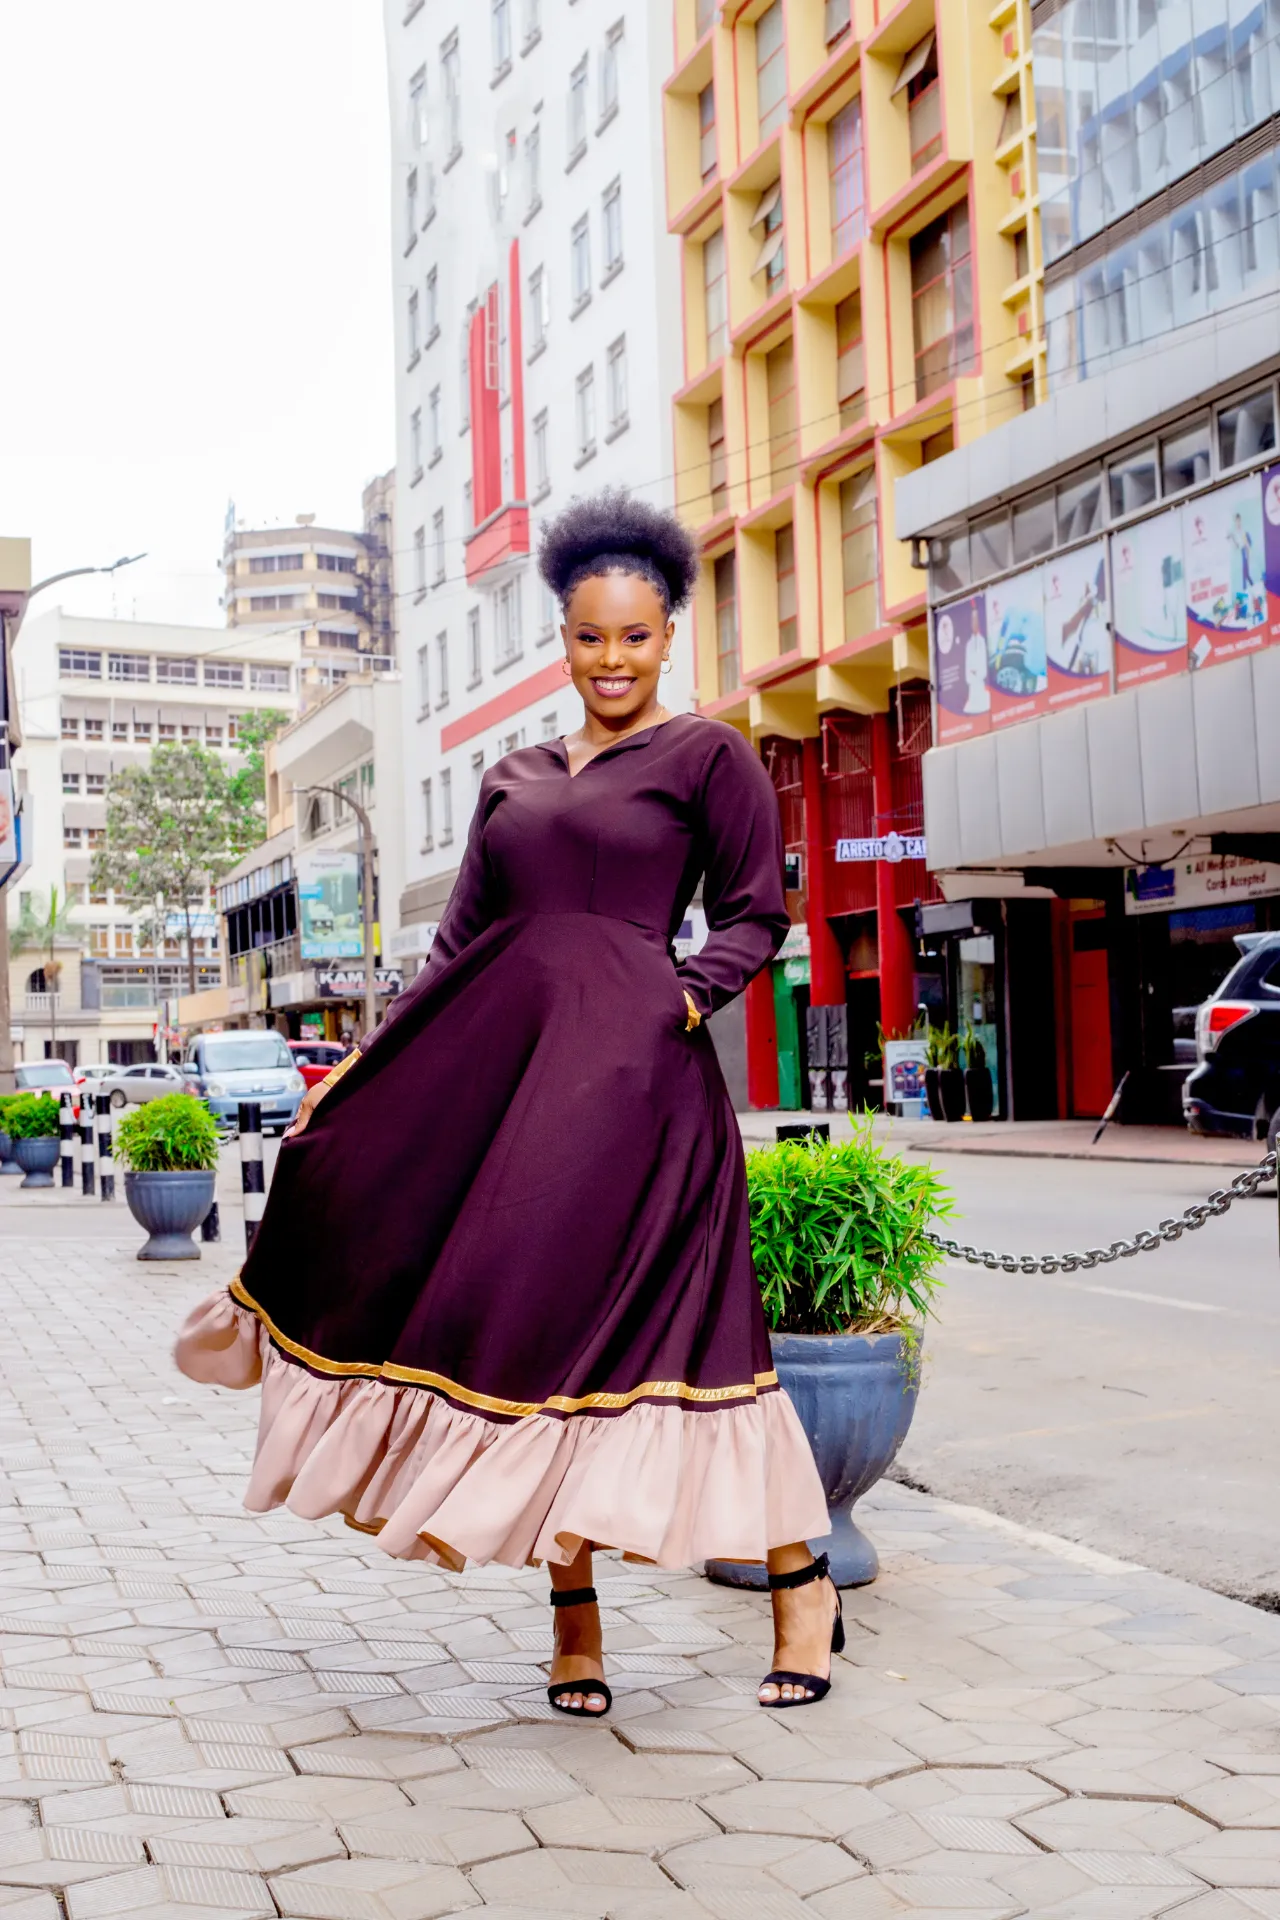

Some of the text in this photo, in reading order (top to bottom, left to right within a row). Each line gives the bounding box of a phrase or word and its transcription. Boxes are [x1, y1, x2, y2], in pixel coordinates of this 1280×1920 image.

[841, 841, 883, 858] ARISTO
[1229, 869, 1267, 888] Accepted
[319, 971, 400, 984] KAMTA
